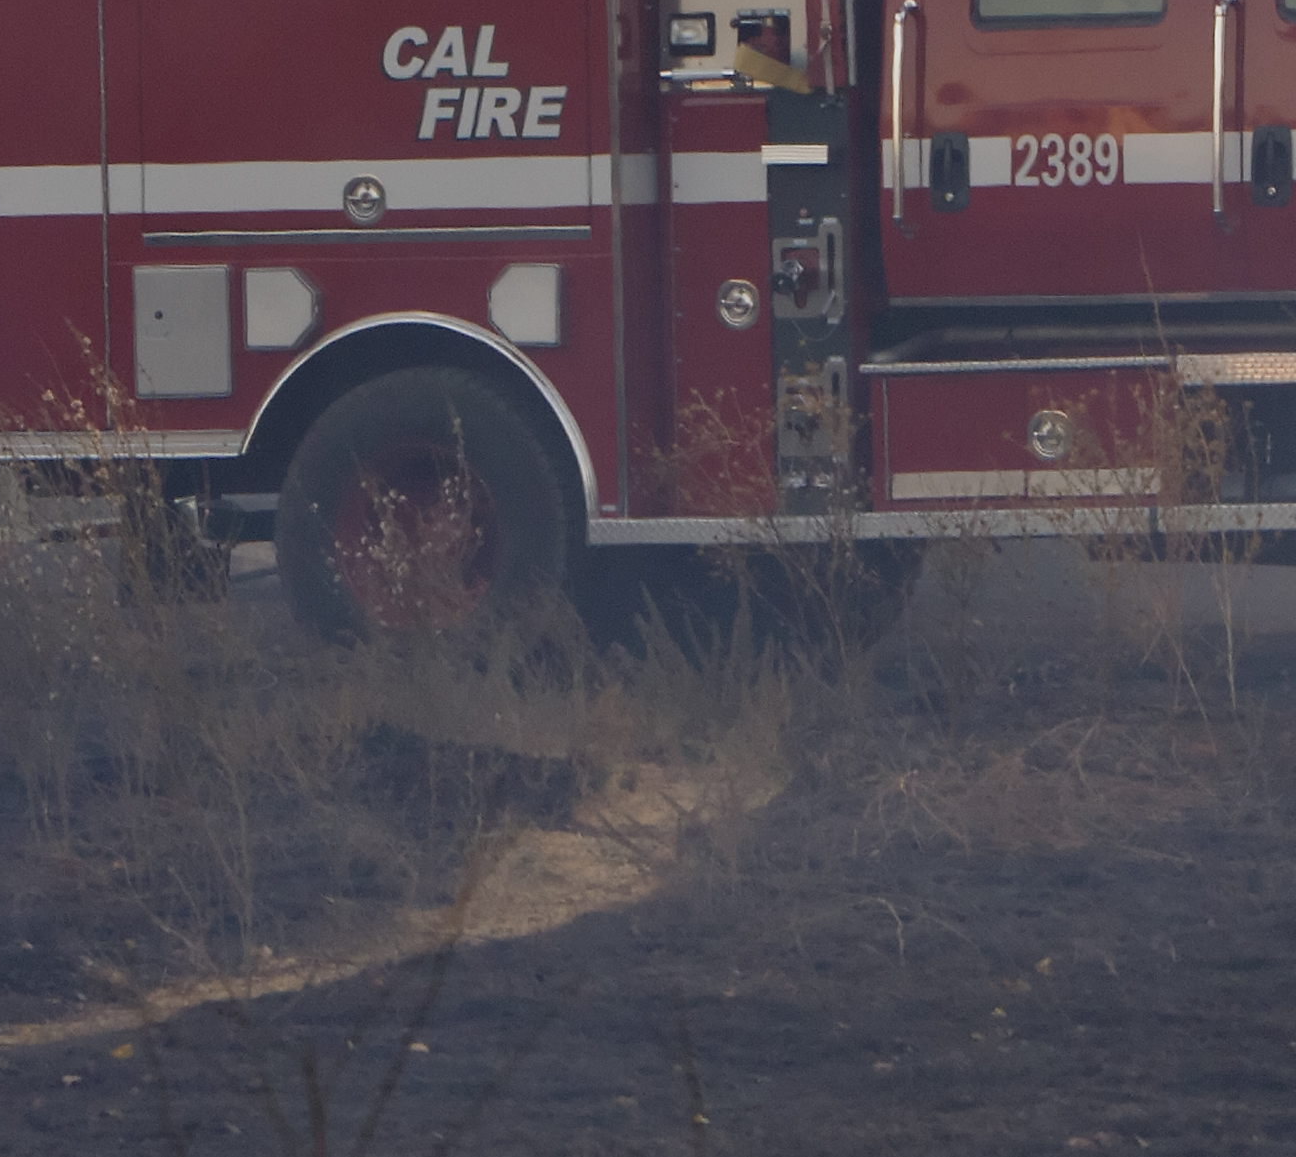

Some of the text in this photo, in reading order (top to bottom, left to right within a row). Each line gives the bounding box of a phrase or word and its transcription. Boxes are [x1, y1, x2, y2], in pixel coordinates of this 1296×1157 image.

[382, 24, 509, 80] CAL
[417, 85, 568, 140] FIRE
[1015, 133, 1119, 186] 2389
